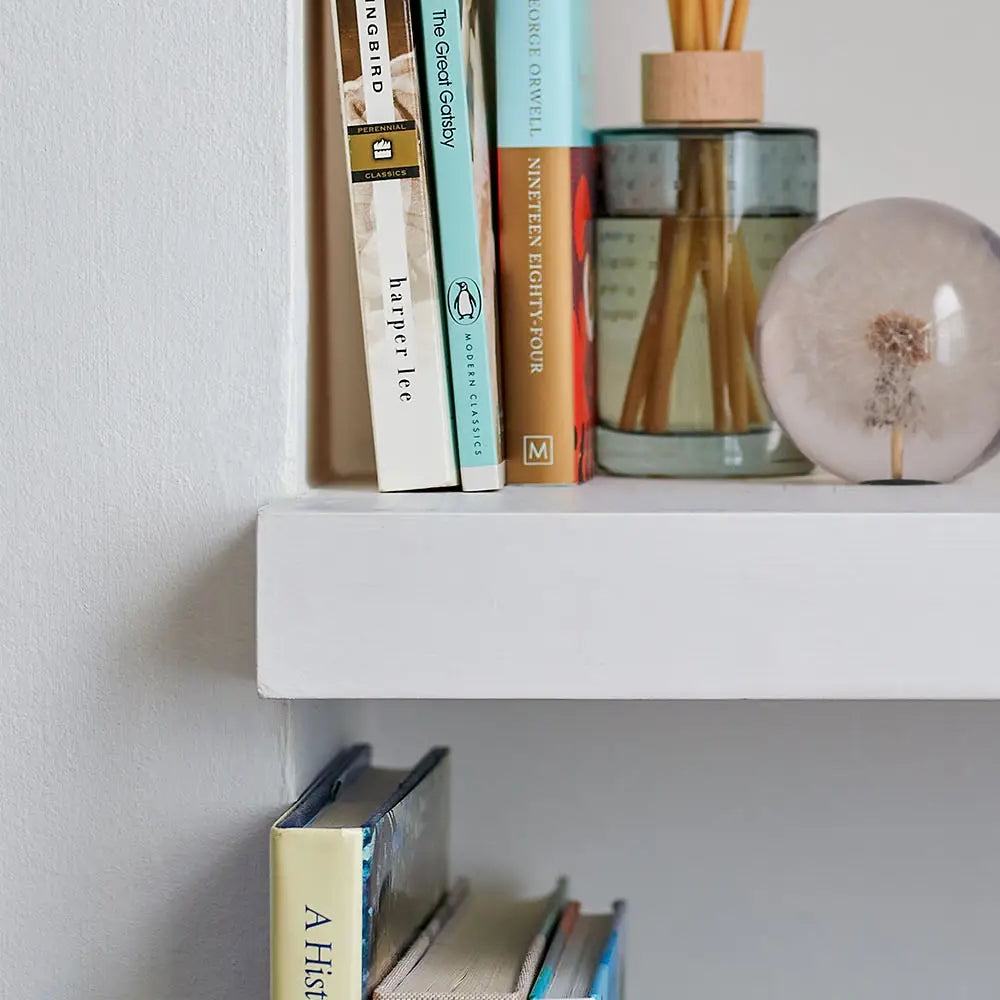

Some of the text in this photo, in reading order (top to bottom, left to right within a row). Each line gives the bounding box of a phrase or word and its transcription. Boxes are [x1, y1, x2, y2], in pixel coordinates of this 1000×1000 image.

[432, 9, 457, 149] The Great Gatsby
[528, 63, 543, 137] ORWELL
[357, 125, 407, 133] PERENNIAL
[365, 170, 407, 179] CLASSICS
[527, 157, 544, 374] NINETEEN EIGHTY-FOUR
[387, 276, 416, 402] harper lee
[464, 333, 482, 456] MODERN CLASSICS
[528, 441, 548, 459] M
[304, 904, 332, 1000] A Hist
